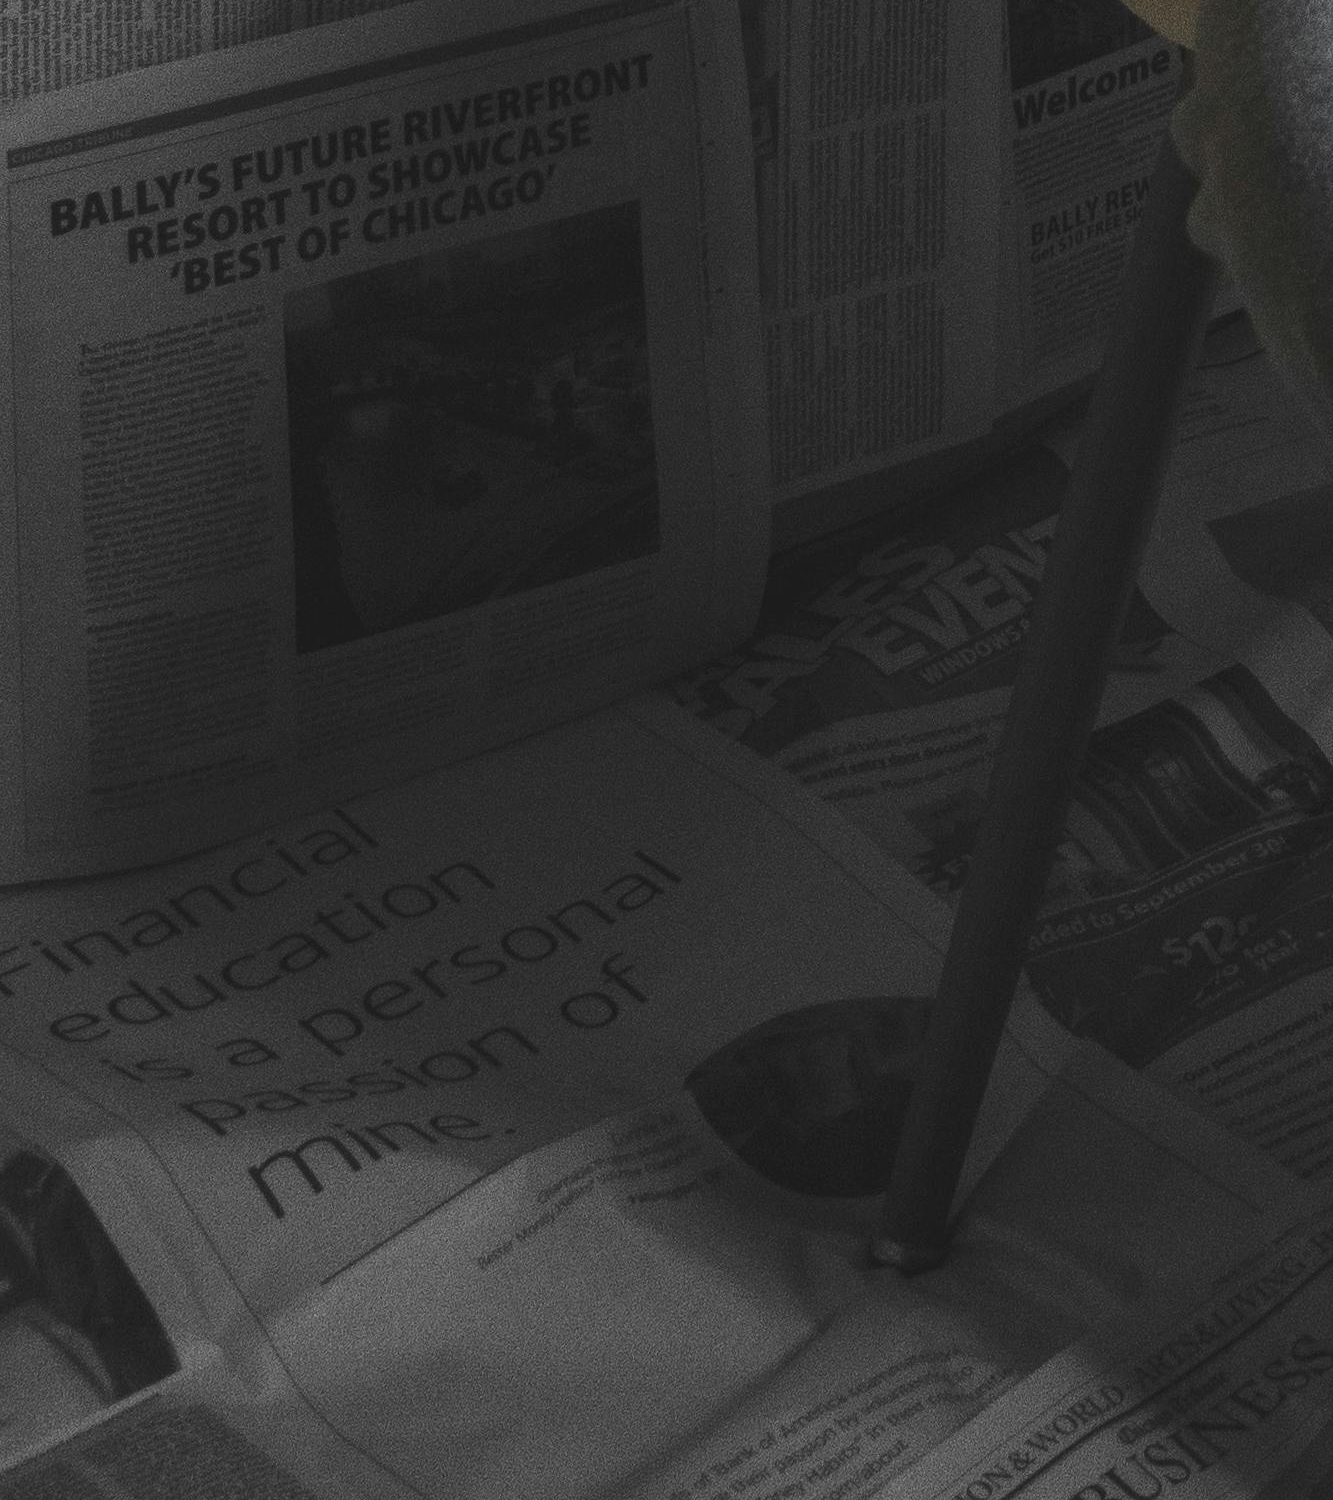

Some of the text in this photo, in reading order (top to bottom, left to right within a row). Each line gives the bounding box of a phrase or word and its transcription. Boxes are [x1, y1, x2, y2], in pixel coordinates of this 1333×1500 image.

[49, 53, 652, 238] BALLY'S FUTURE RIVERFRONT
[126, 113, 591, 264] RESORT TO SHOWCASE
[170, 164, 555, 296] 'BEST OF CHICAGO'
[0, 808, 378, 995] Financial
[49, 861, 495, 1043] education
[100, 850, 682, 1083] is a personal
[180, 953, 644, 1135] passion of
[249, 1113, 515, 1219] mine.
